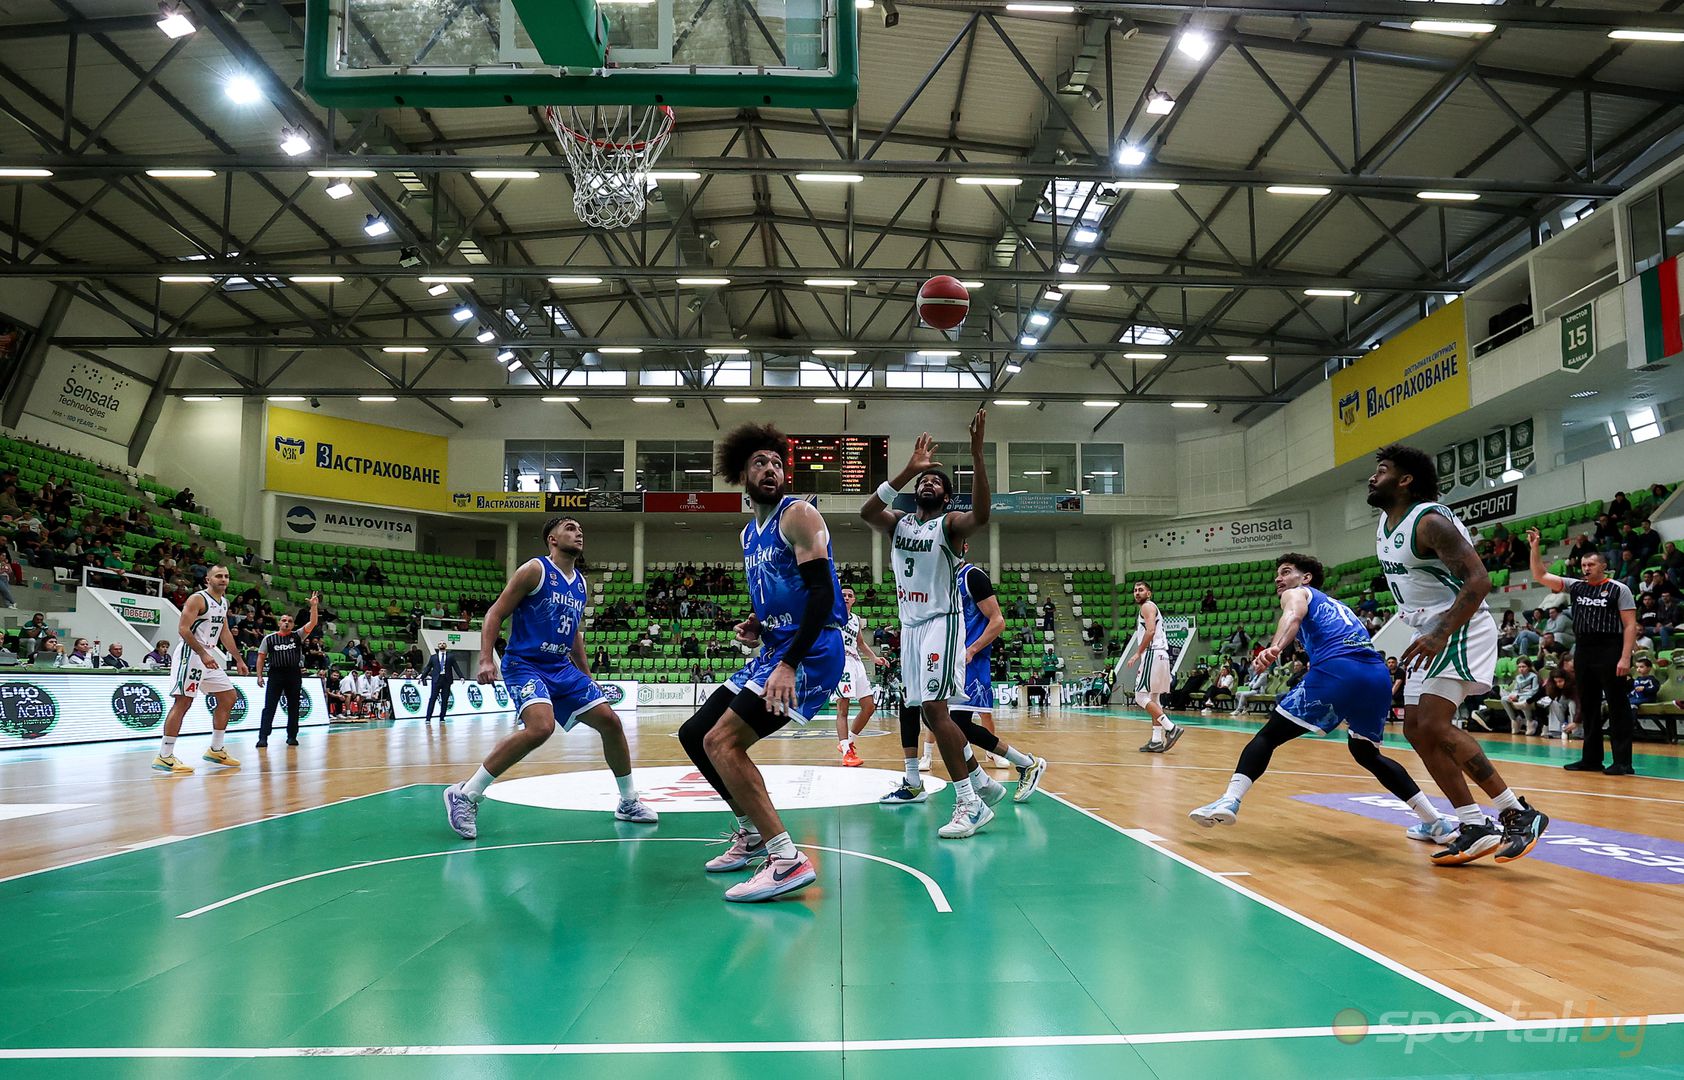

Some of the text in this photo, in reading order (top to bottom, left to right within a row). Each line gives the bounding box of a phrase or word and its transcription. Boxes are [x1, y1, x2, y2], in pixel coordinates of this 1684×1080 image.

[1568, 324, 1587, 351] 15
[63, 377, 120, 412] Sensata
[1366, 354, 1458, 418] ЗАСТРАХОВАНЕ
[58, 393, 106, 419] Technologies
[317, 443, 440, 485] ЗАСТРАХОВАНЕ
[477, 496, 540, 509] ЗАСТРАХОВАНЕ
[553, 494, 588, 507] ЛКС
[325, 513, 412, 533] MALYOVITSA
[1231, 518, 1293, 536] Sensata
[895, 536, 934, 552] BALKAN
[1232, 533, 1283, 545] Technologies
[745, 546, 773, 570] RILSKI
[904, 558, 915, 577] 3
[552, 591, 583, 612] RILSKI
[1391, 582, 1405, 605] 0
[123, 608, 154, 620] ПОБЕДА!
[557, 615, 573, 635] 35
[273, 642, 297, 651] efbet
[189, 668, 202, 681] 33
[1, 686, 39, 698] БИО
[123, 686, 150, 697] БИО
[185, 682, 200, 693] A1
